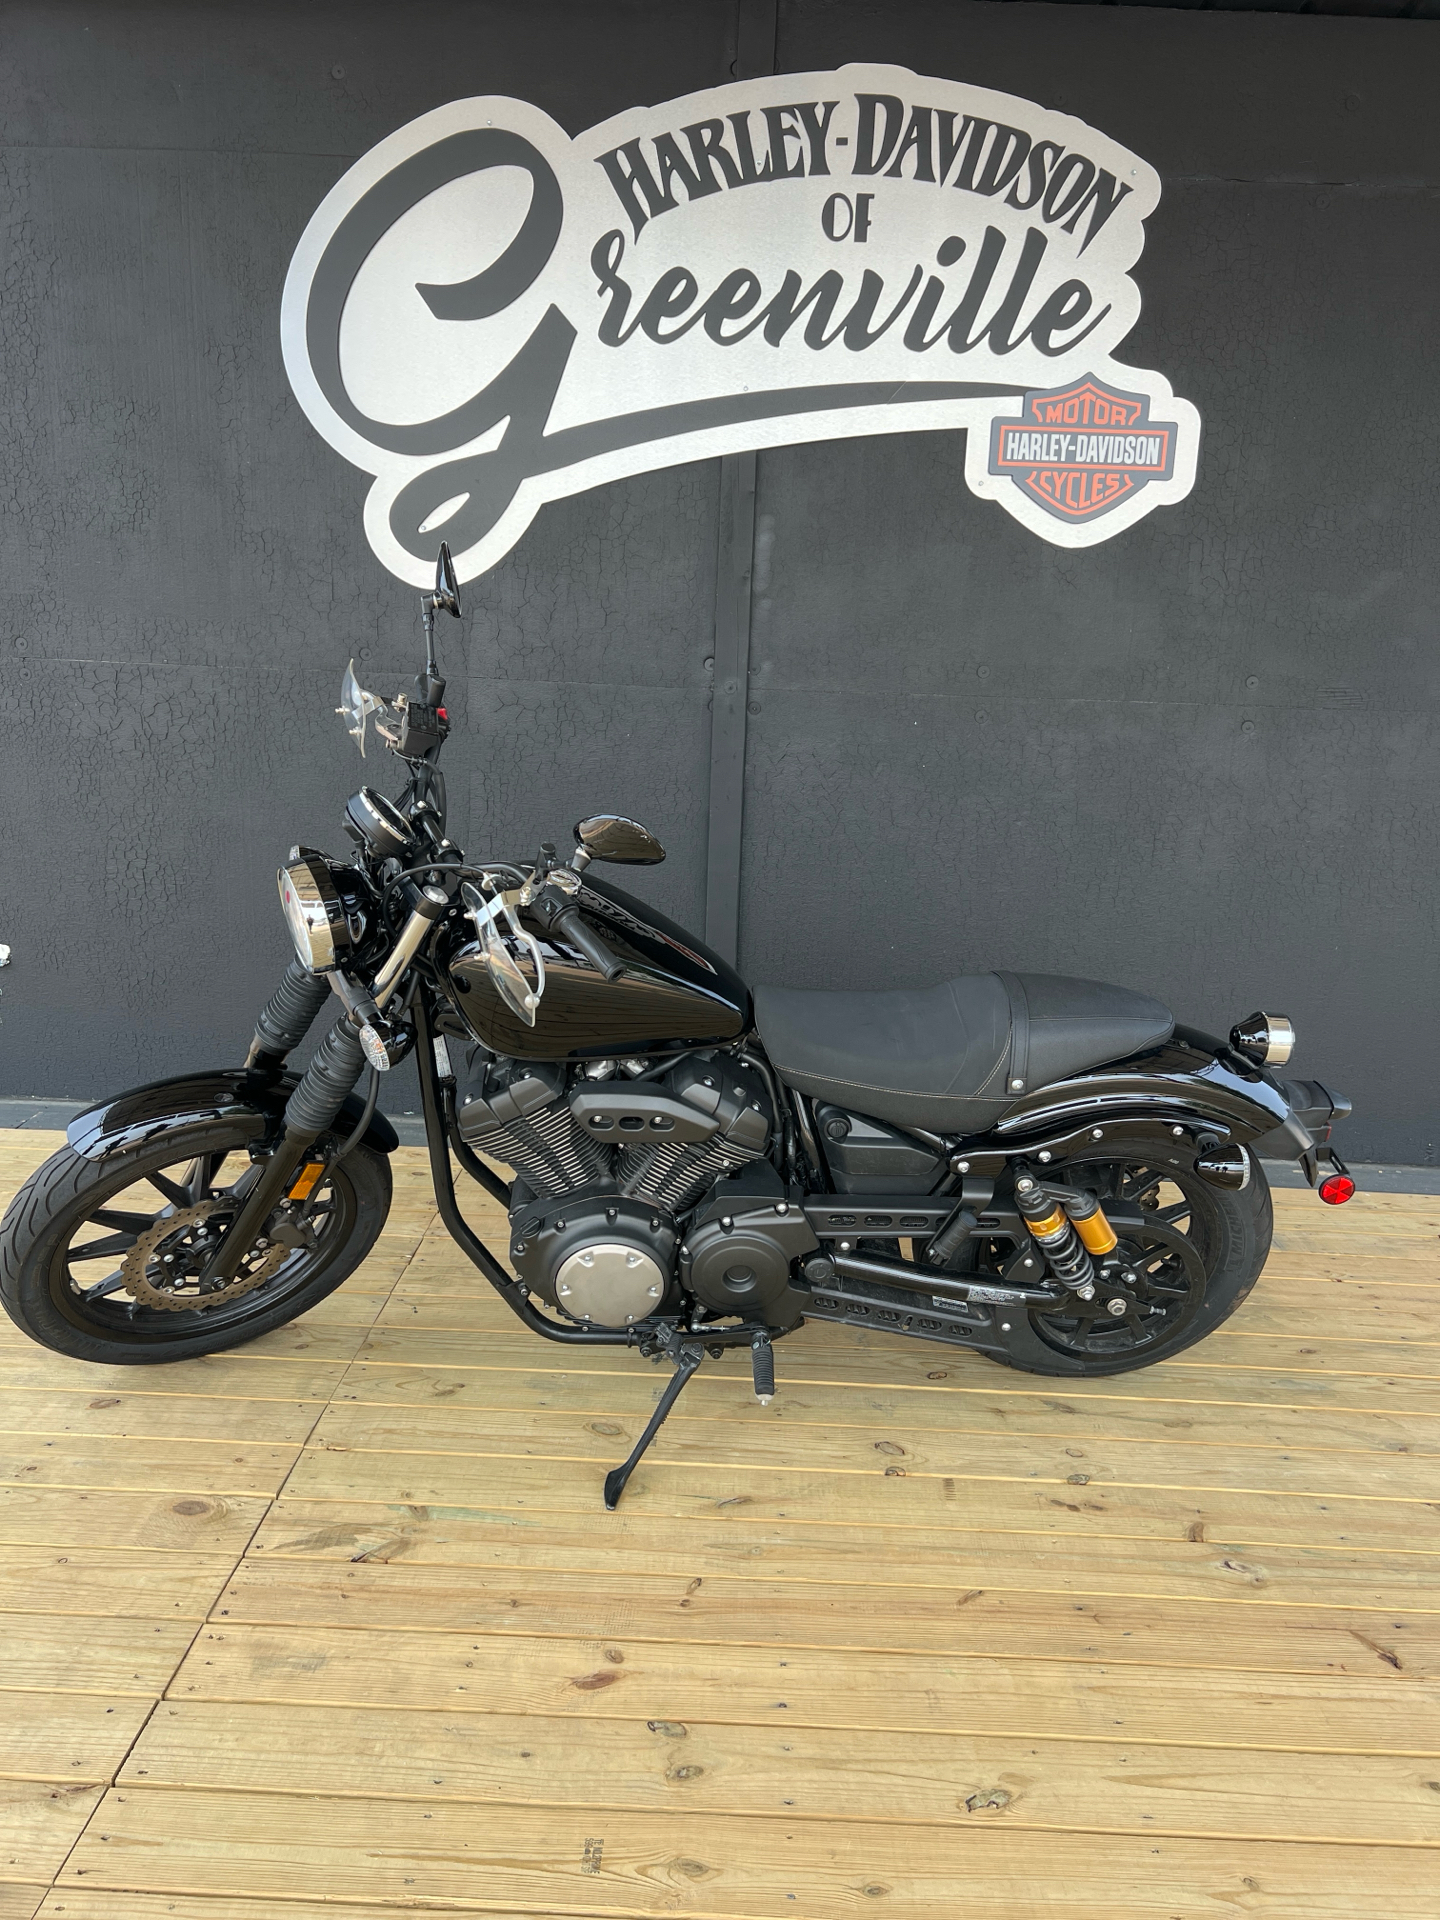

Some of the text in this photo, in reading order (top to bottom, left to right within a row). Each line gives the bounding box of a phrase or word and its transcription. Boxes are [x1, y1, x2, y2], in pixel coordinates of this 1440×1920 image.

[593, 93, 1134, 259] HARLEY-DAVIDSON
[821, 192, 875, 243] OF
[306, 127, 1112, 563] Greenville
[1045, 391, 1127, 426] MOTOR
[1006, 432, 1161, 465] HARLEY-DAVIDSON
[1039, 471, 1120, 509] CYCLES
